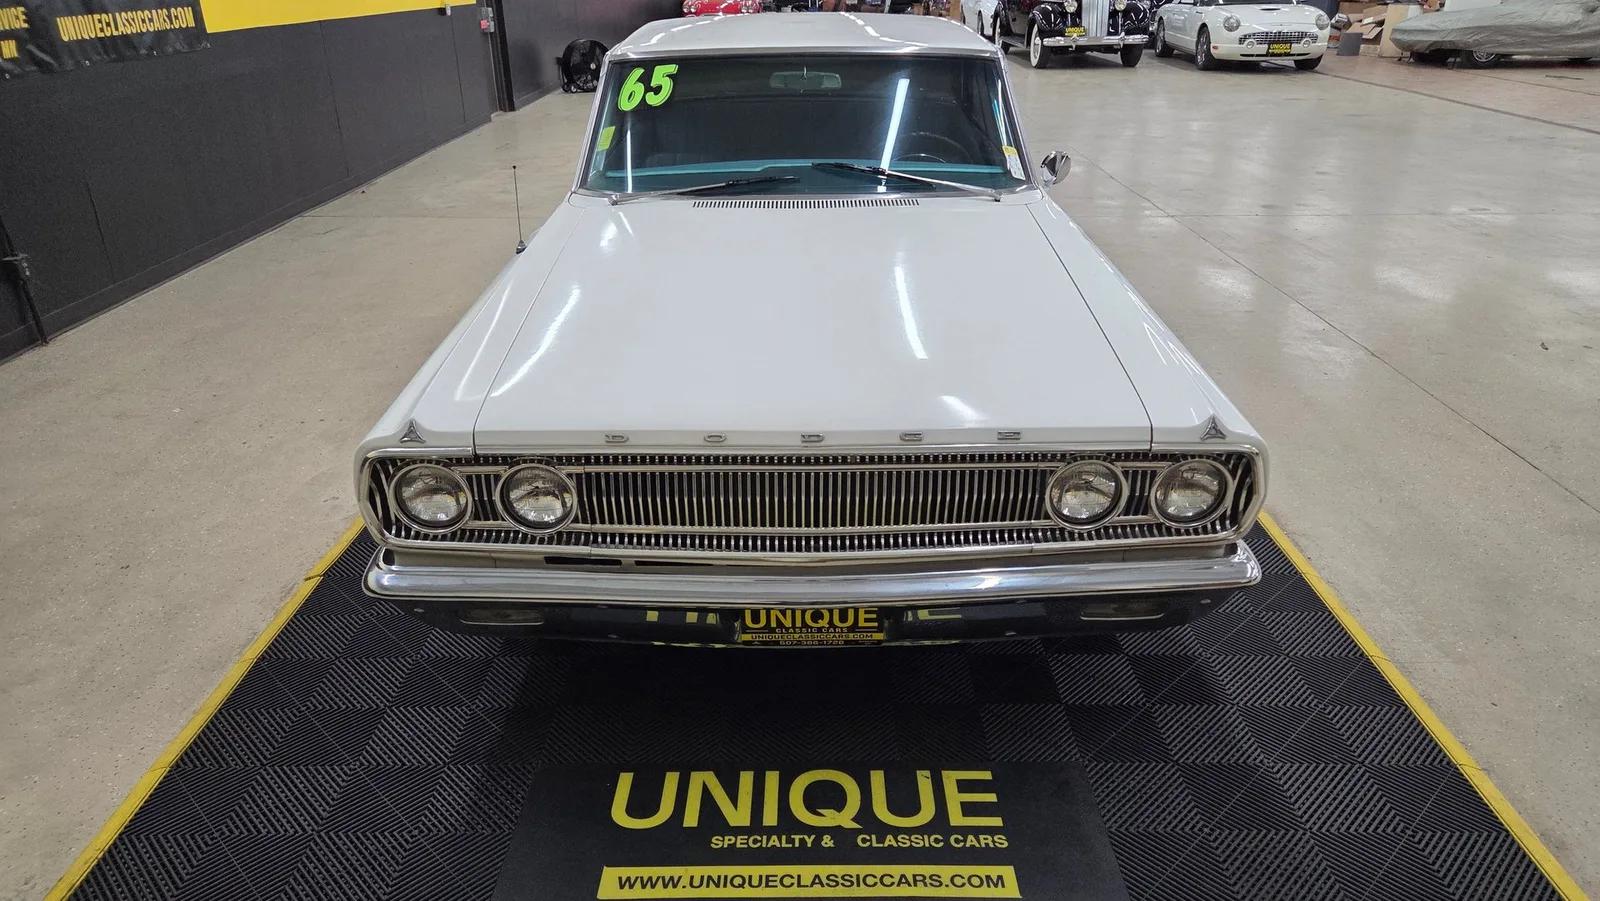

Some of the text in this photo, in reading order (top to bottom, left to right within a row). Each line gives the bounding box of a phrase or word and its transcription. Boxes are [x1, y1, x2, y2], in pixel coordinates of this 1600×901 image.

[0, 6, 30, 31] VICE
[56, 6, 196, 42] UNIQUECLASSICCARS.COM
[617, 64, 678, 111] 65
[744, 607, 879, 628] UNIQUE
[751, 633, 874, 641] UNIQUECLASSICCARS.COM
[610, 769, 1005, 830] UNIQUE
[710, 833, 1009, 849] SPECIALTY & CLASSIC CARS
[617, 873, 1006, 890] WWW.UNIQUECLASSICCARS.COM
